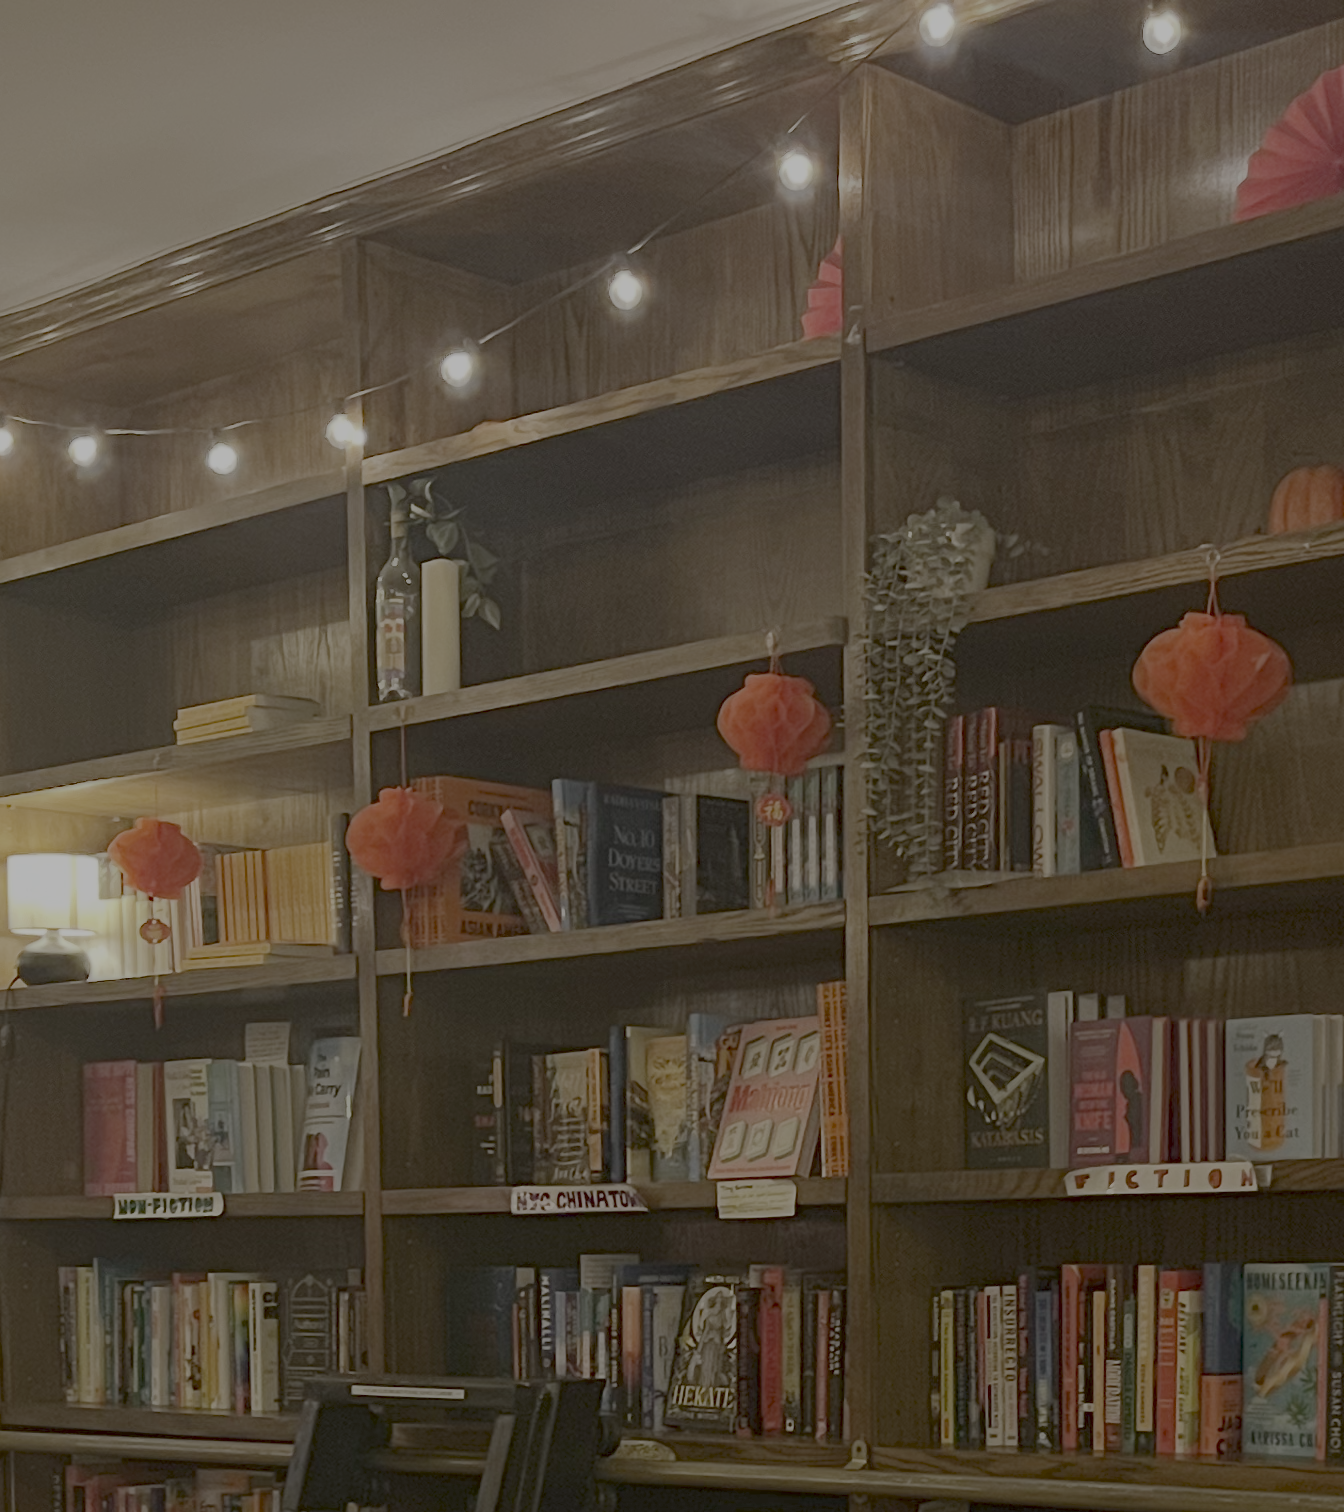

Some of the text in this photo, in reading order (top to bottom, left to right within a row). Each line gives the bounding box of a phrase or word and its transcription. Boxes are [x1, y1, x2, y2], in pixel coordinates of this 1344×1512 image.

[991, 1009, 1044, 1027] KUANG
[729, 1082, 812, 1112] Mahjong
[1235, 1104, 1299, 1119] Prescribe
[1234, 1126, 1259, 1141] You
[1275, 1125, 1300, 1140] Cat
[1073, 1168, 1255, 1190] FICTION
[118, 1197, 214, 1215] NON-FICTION
[1004, 1292, 1016, 1383] INSURRECTO
[1177, 1302, 1187, 1355] BESTIARY
[672, 1385, 735, 1408] HEKATE
[1104, 1360, 1121, 1424] MODERATION
[1330, 1372, 1343, 1408] SUSAN
[1328, 1412, 1342, 1451] CHOI
